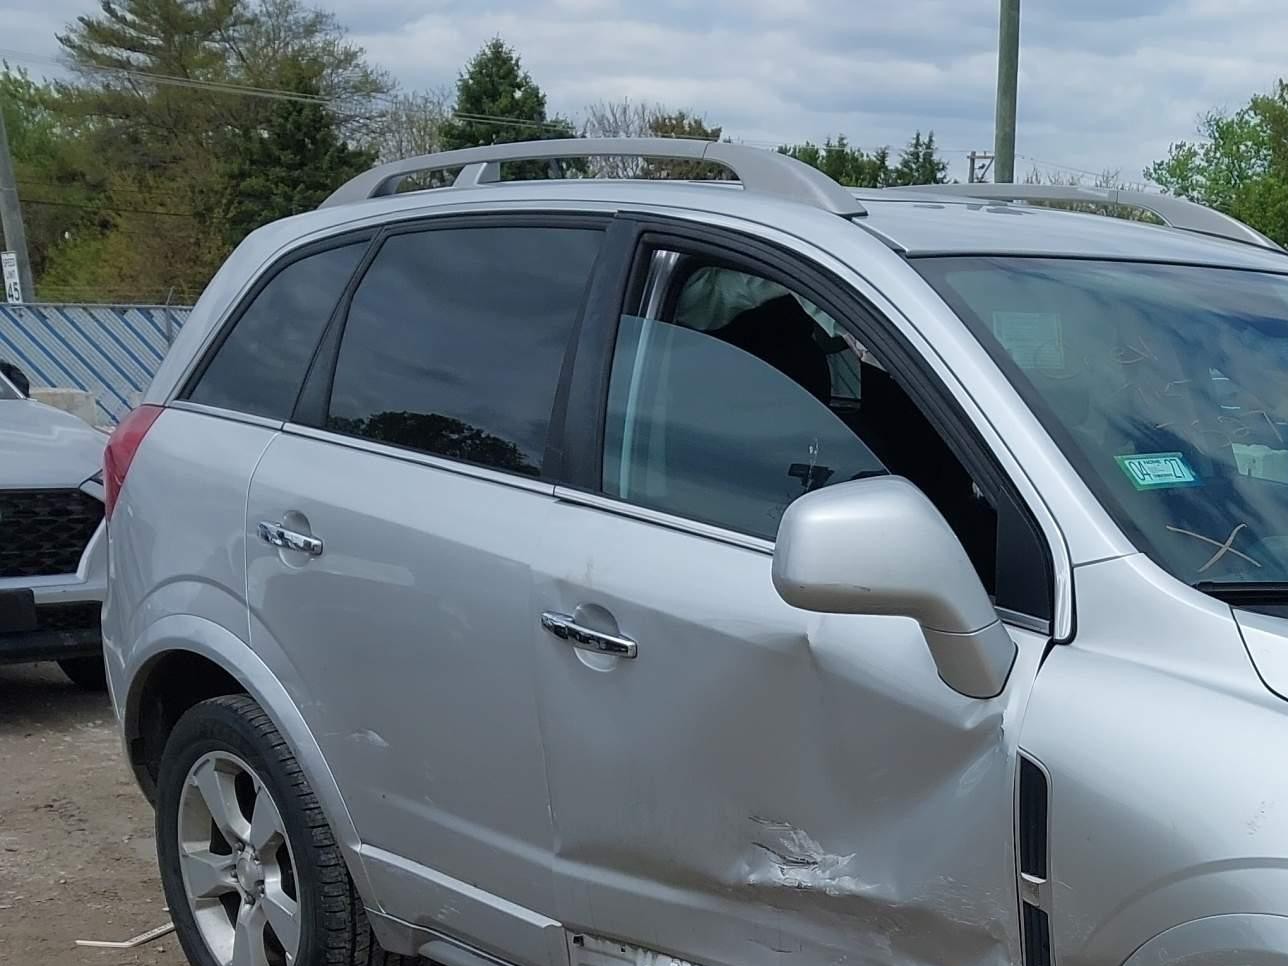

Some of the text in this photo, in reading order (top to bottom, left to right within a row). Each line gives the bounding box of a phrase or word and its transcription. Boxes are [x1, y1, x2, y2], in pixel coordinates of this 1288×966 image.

[8, 281, 20, 301] 45
[1128, 458, 1186, 480] 04 27
